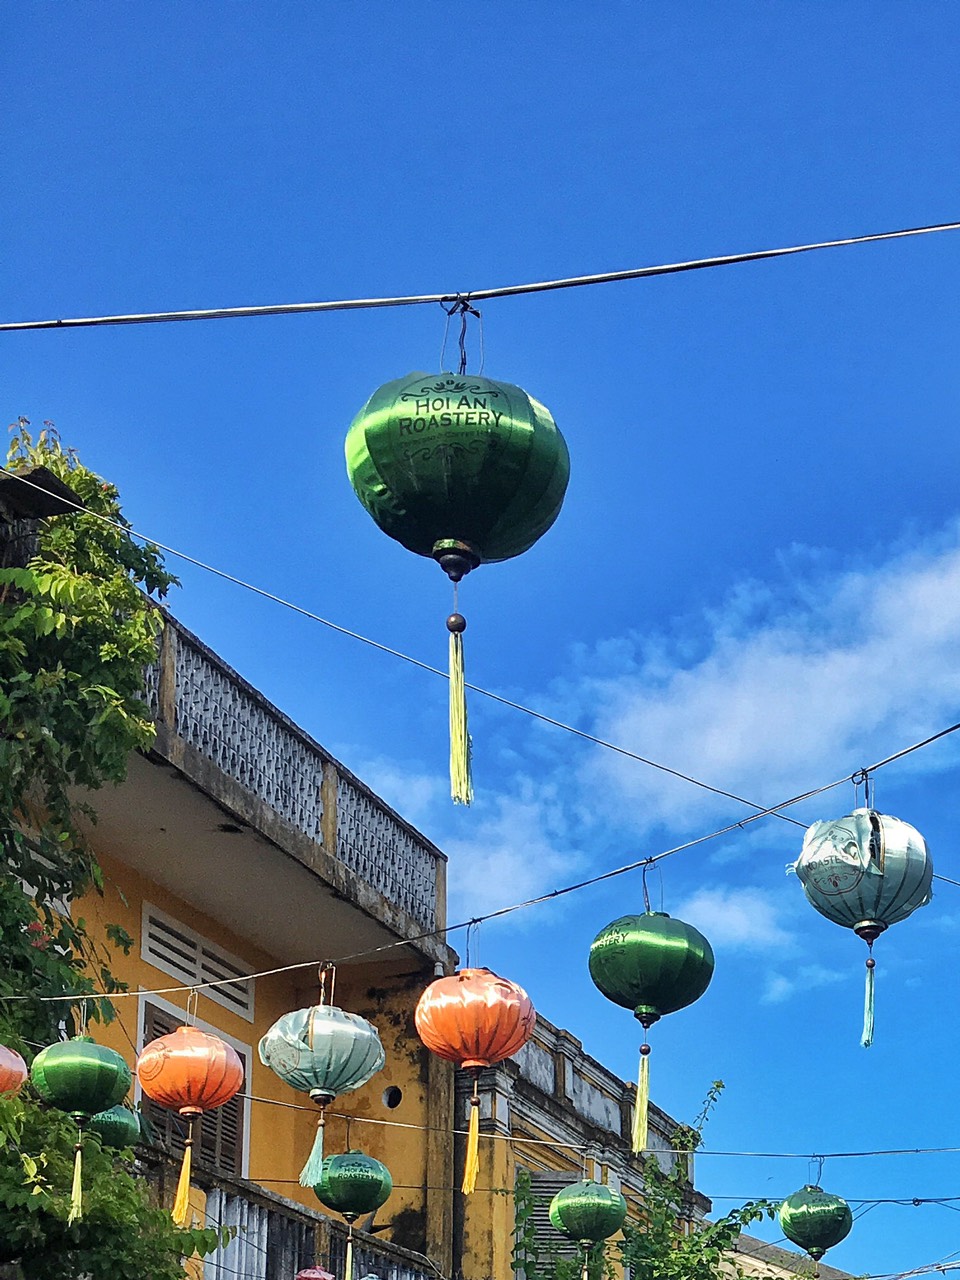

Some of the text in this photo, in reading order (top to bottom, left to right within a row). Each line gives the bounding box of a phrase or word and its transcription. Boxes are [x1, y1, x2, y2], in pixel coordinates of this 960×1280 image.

[415, 395, 486, 415] HOI AN
[398, 410, 503, 436] ROASTERY
